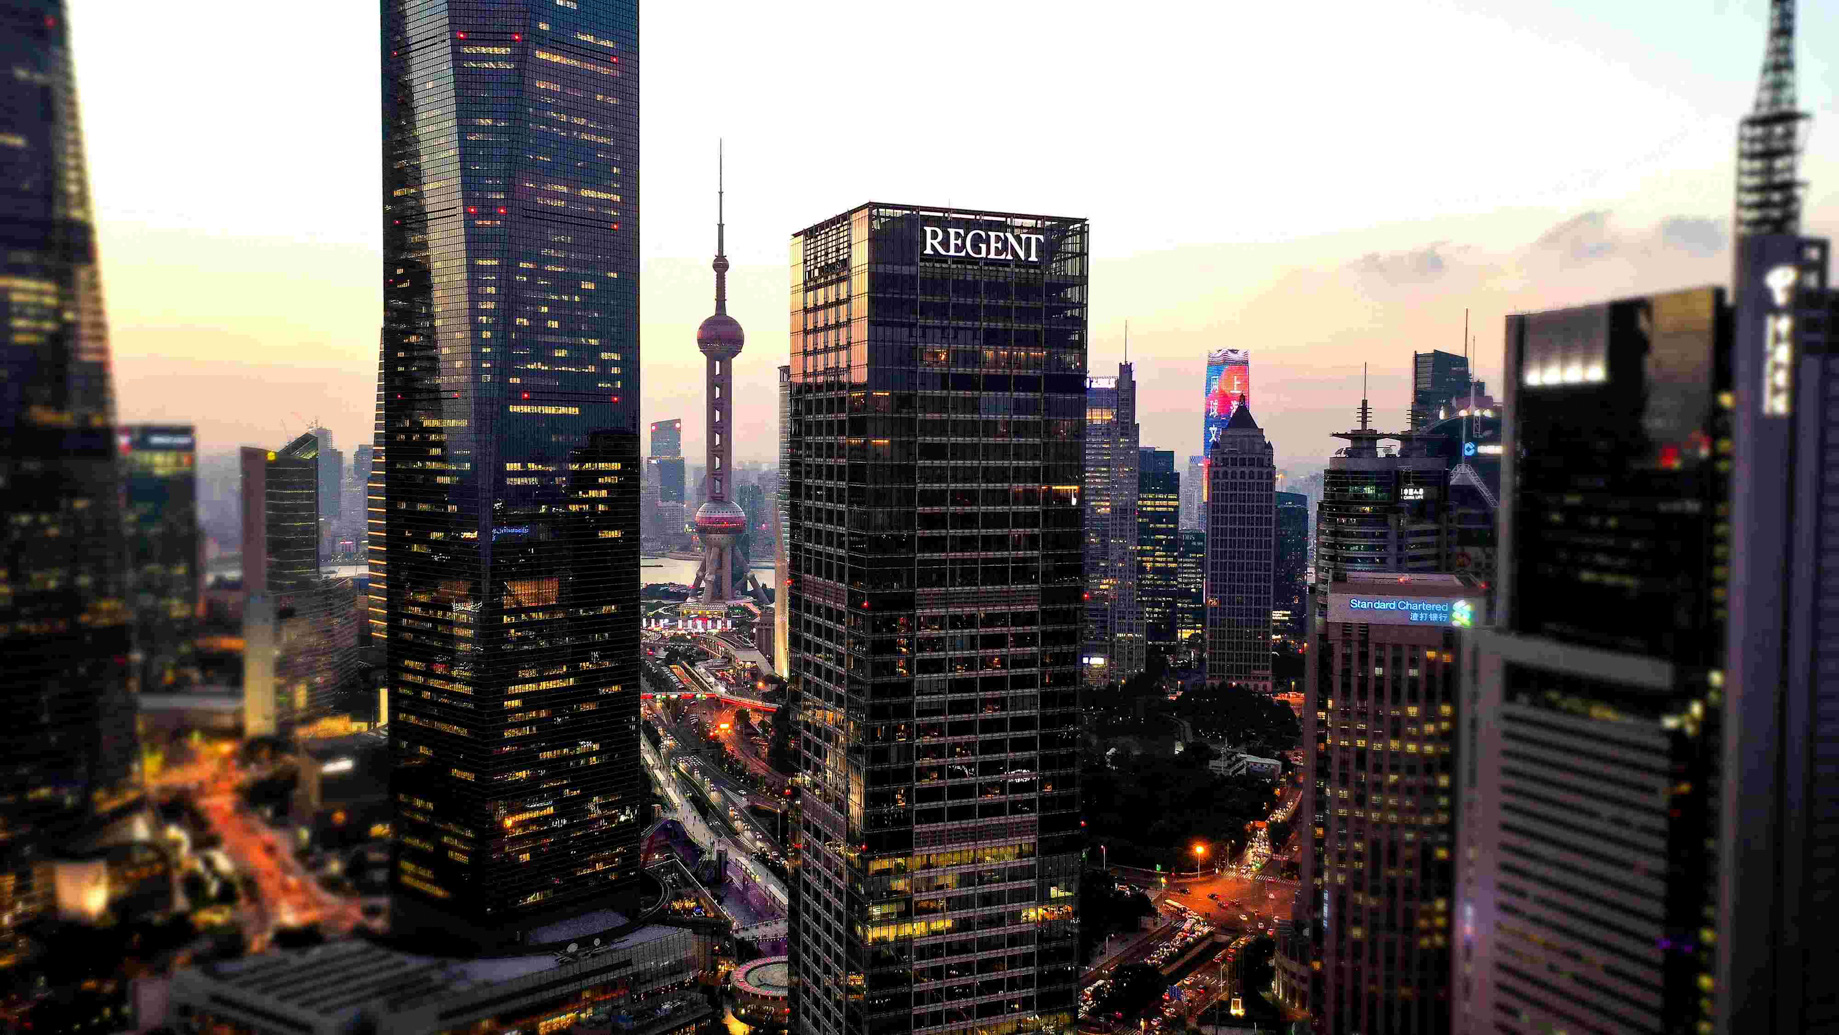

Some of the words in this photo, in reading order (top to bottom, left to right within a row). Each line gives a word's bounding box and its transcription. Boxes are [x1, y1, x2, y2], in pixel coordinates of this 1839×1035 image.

[923, 226, 1044, 261] REGENT
[1350, 599, 1396, 610] Standard
[1397, 600, 1448, 612] Chartered
[1410, 612, 1448, 622] 渣打银行
